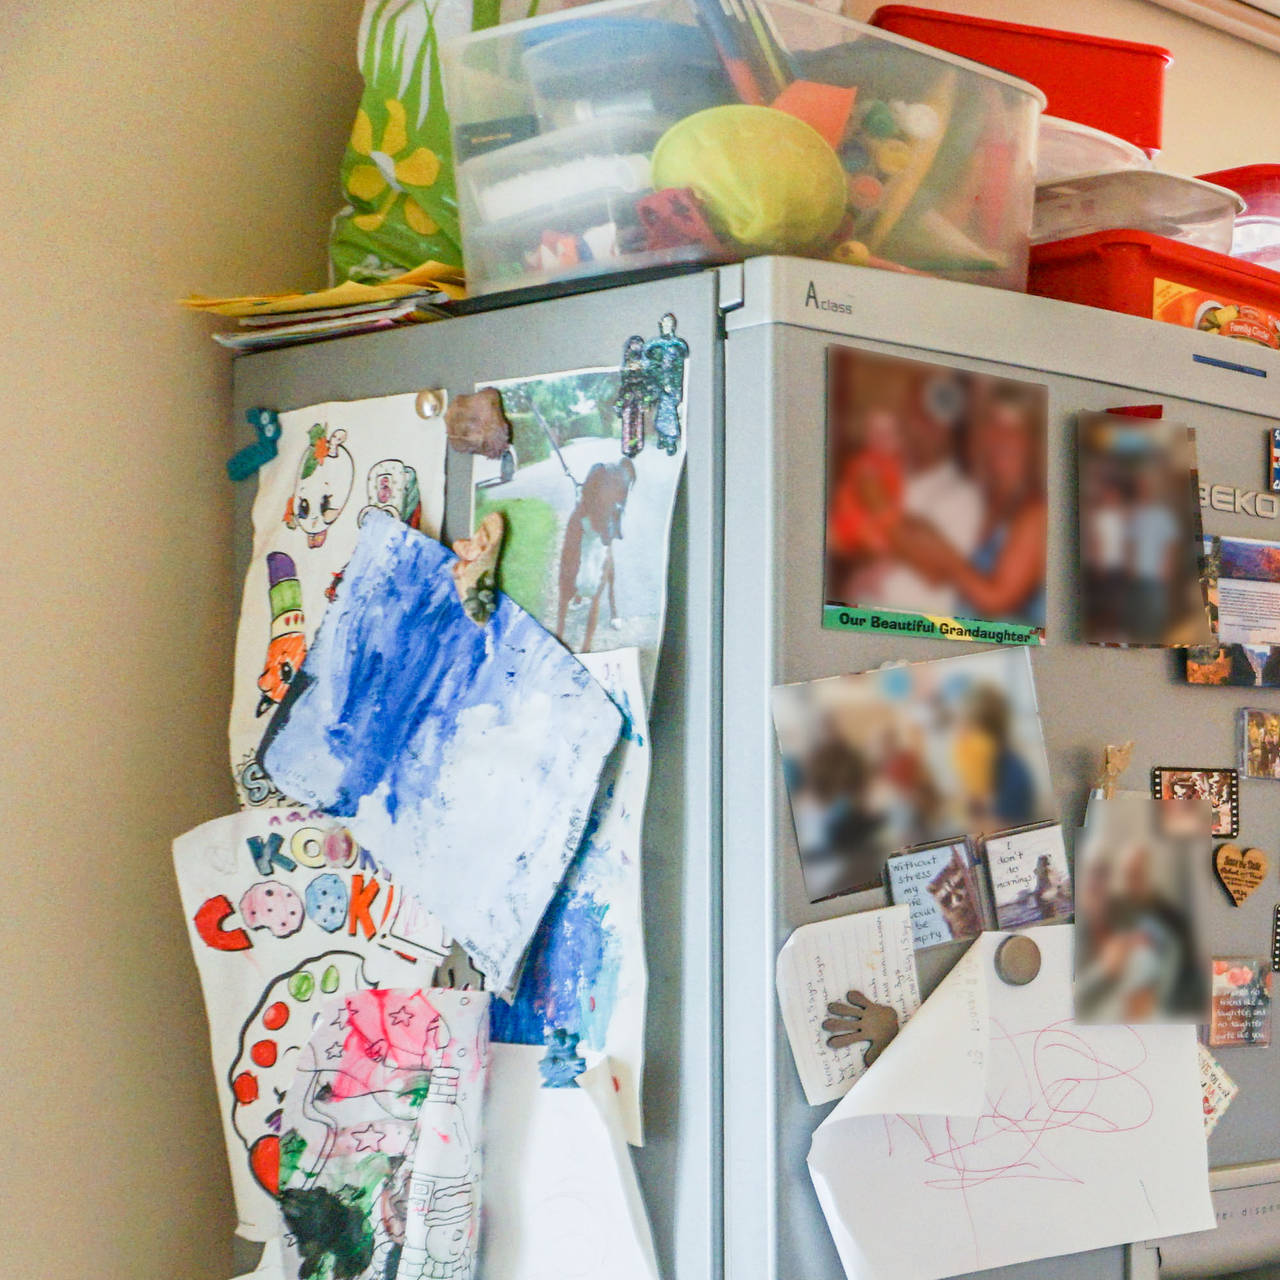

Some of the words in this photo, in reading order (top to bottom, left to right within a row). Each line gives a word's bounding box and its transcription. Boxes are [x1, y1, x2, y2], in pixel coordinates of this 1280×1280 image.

[805, 280, 819, 308] A
[820, 299, 853, 315] class
[1229, 322, 1251, 335] Family
[838, 612, 867, 627] Our
[870, 615, 935, 634] Beautiful
[939, 622, 1031, 644] Grandaughter
[891, 855, 937, 872] Without
[997, 851, 1023, 864] don't
[898, 870, 932, 884] stress
[904, 886, 919, 897] my
[913, 931, 943, 945] mpty
